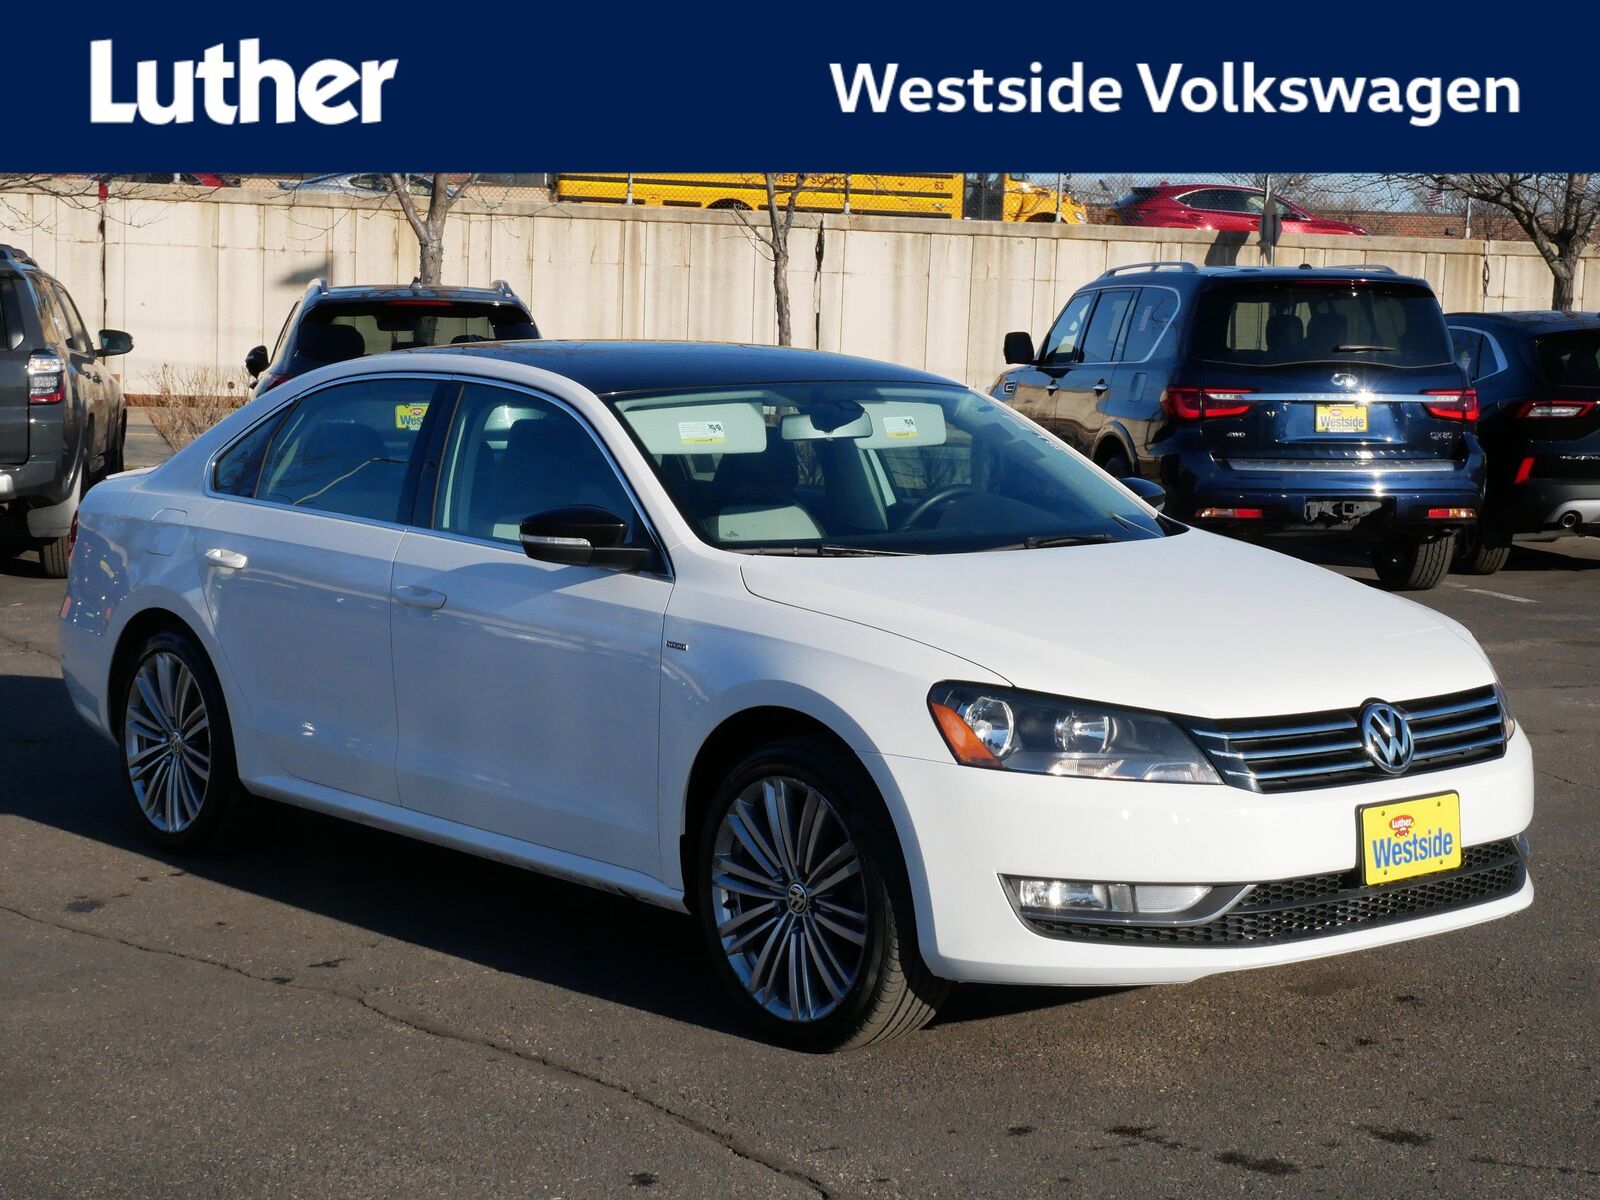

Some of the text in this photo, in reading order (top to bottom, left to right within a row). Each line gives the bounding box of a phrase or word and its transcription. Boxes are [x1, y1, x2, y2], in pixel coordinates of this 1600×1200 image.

[1320, 415, 1364, 428] Westside
[1391, 817, 1413, 829] Luther
[1371, 827, 1454, 869] Westside
